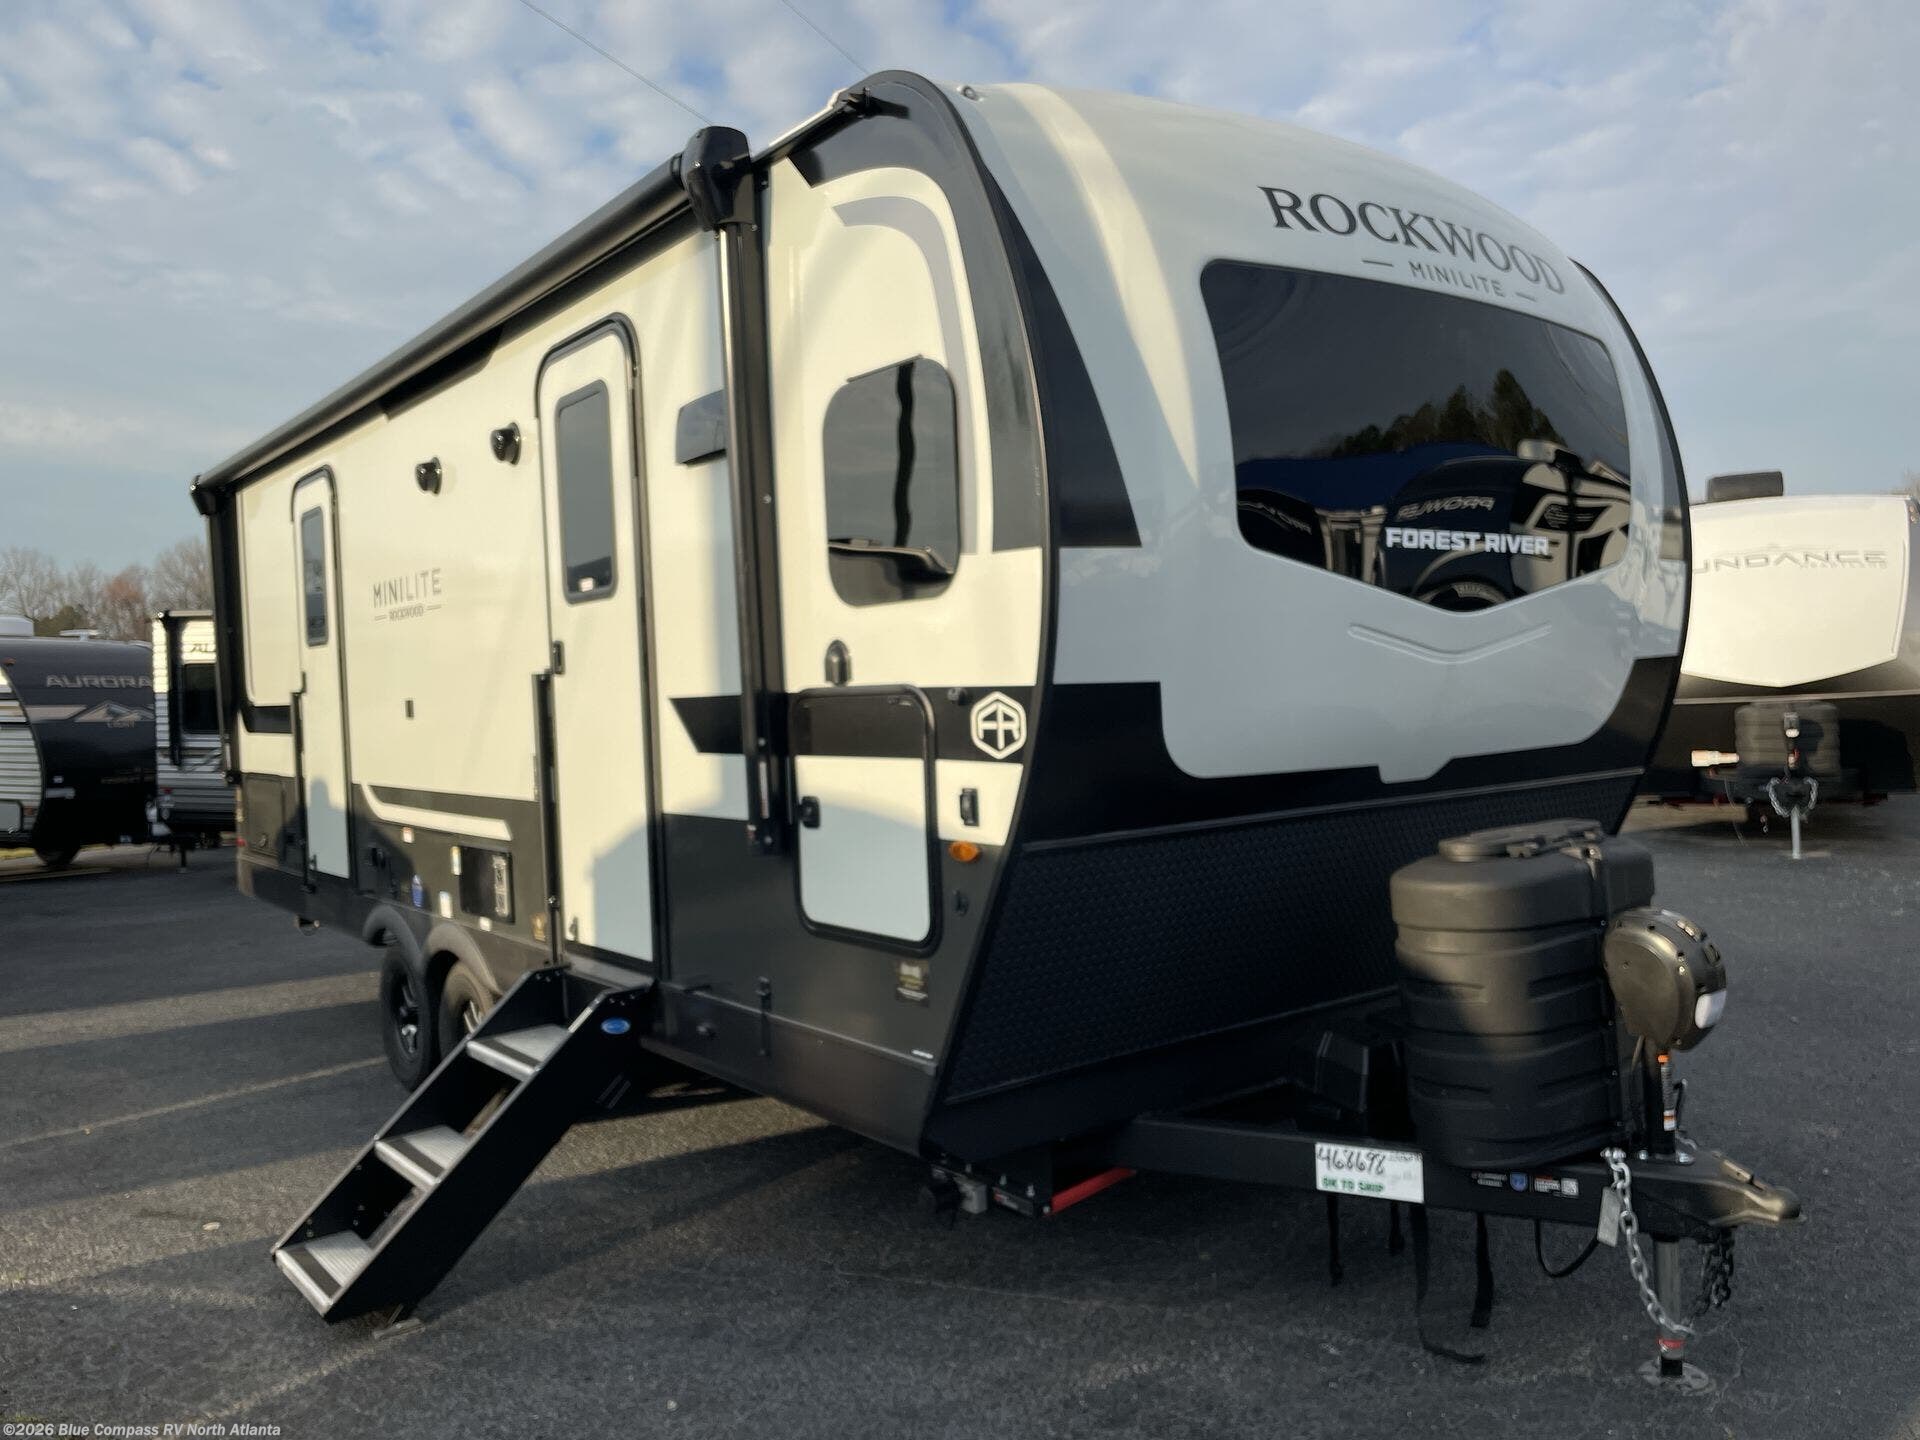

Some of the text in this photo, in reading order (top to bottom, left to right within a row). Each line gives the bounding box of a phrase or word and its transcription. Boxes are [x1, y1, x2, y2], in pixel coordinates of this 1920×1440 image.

[1257, 186, 1566, 296] ROCKWOOD
[1409, 261, 1506, 298] MINILITE
[1385, 526, 1550, 556] FOREST RIVER
[373, 567, 442, 609] MINILITE
[46, 674, 152, 688] AURORA
